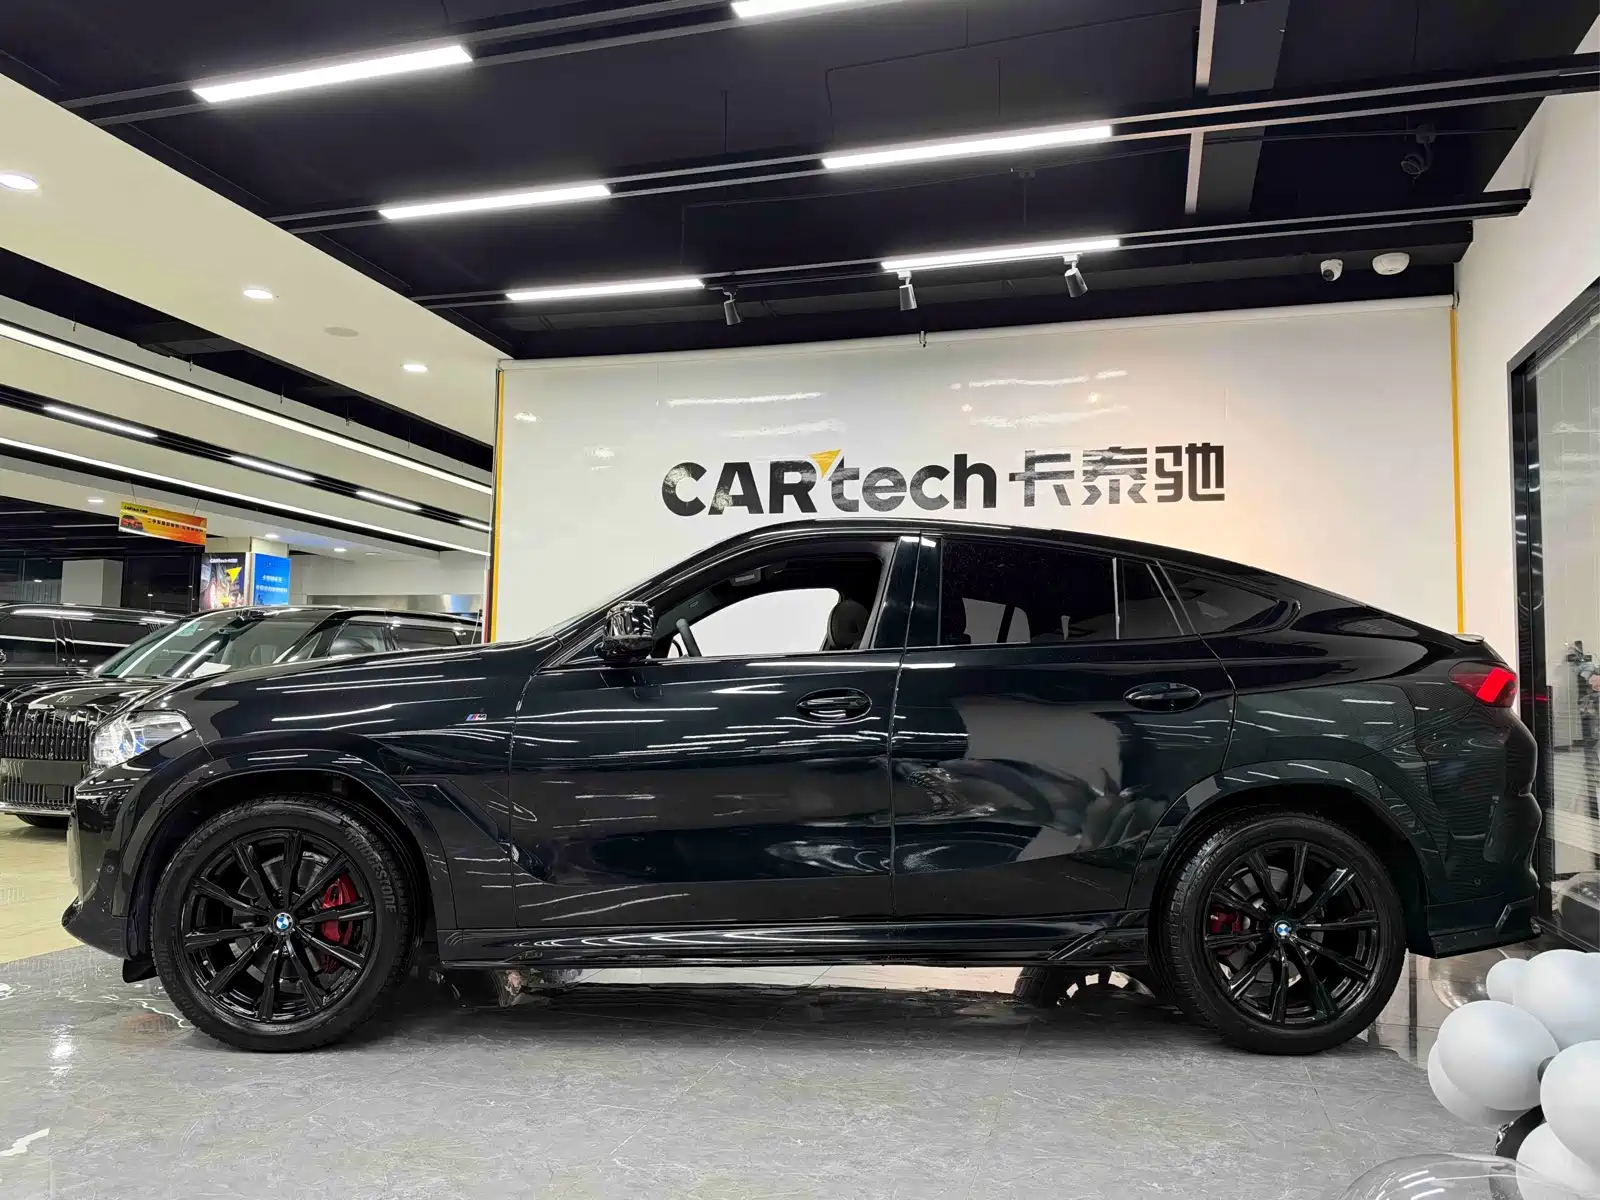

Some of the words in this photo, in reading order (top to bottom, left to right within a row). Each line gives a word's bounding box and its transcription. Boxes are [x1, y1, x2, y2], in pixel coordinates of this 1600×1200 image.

[661, 451, 997, 517] CARtech
[1009, 442, 1225, 506] 卡泰驰
